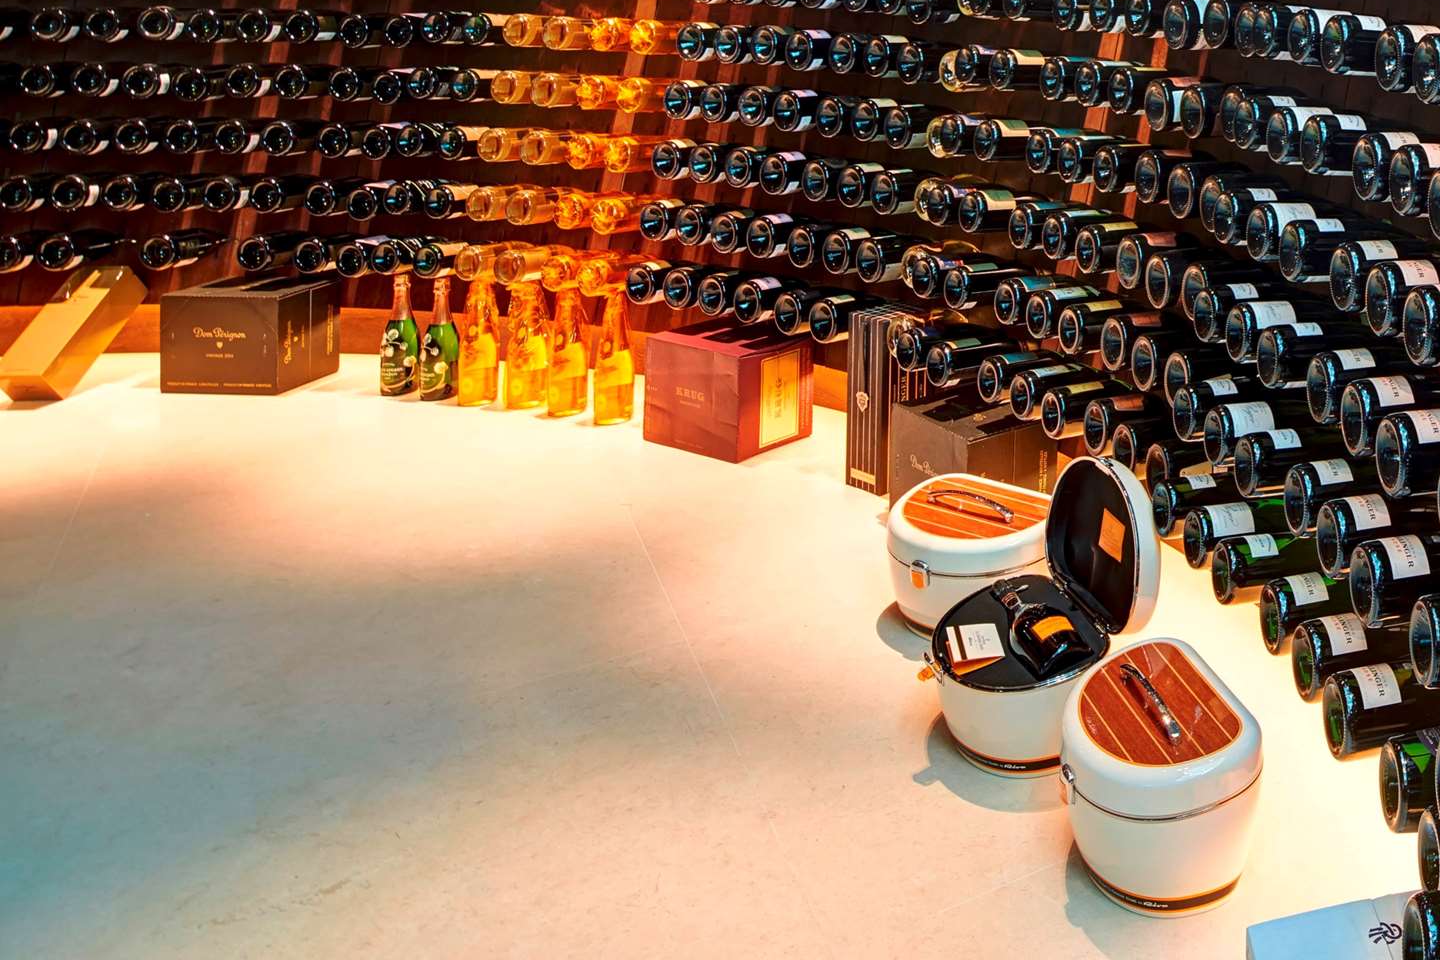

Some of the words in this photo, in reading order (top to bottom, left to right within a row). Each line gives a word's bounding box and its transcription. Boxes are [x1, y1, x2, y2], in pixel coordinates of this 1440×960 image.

[192, 326, 213, 339] Dom
[676, 387, 705, 402] KRUG
[1143, 900, 1169, 908] Riva
